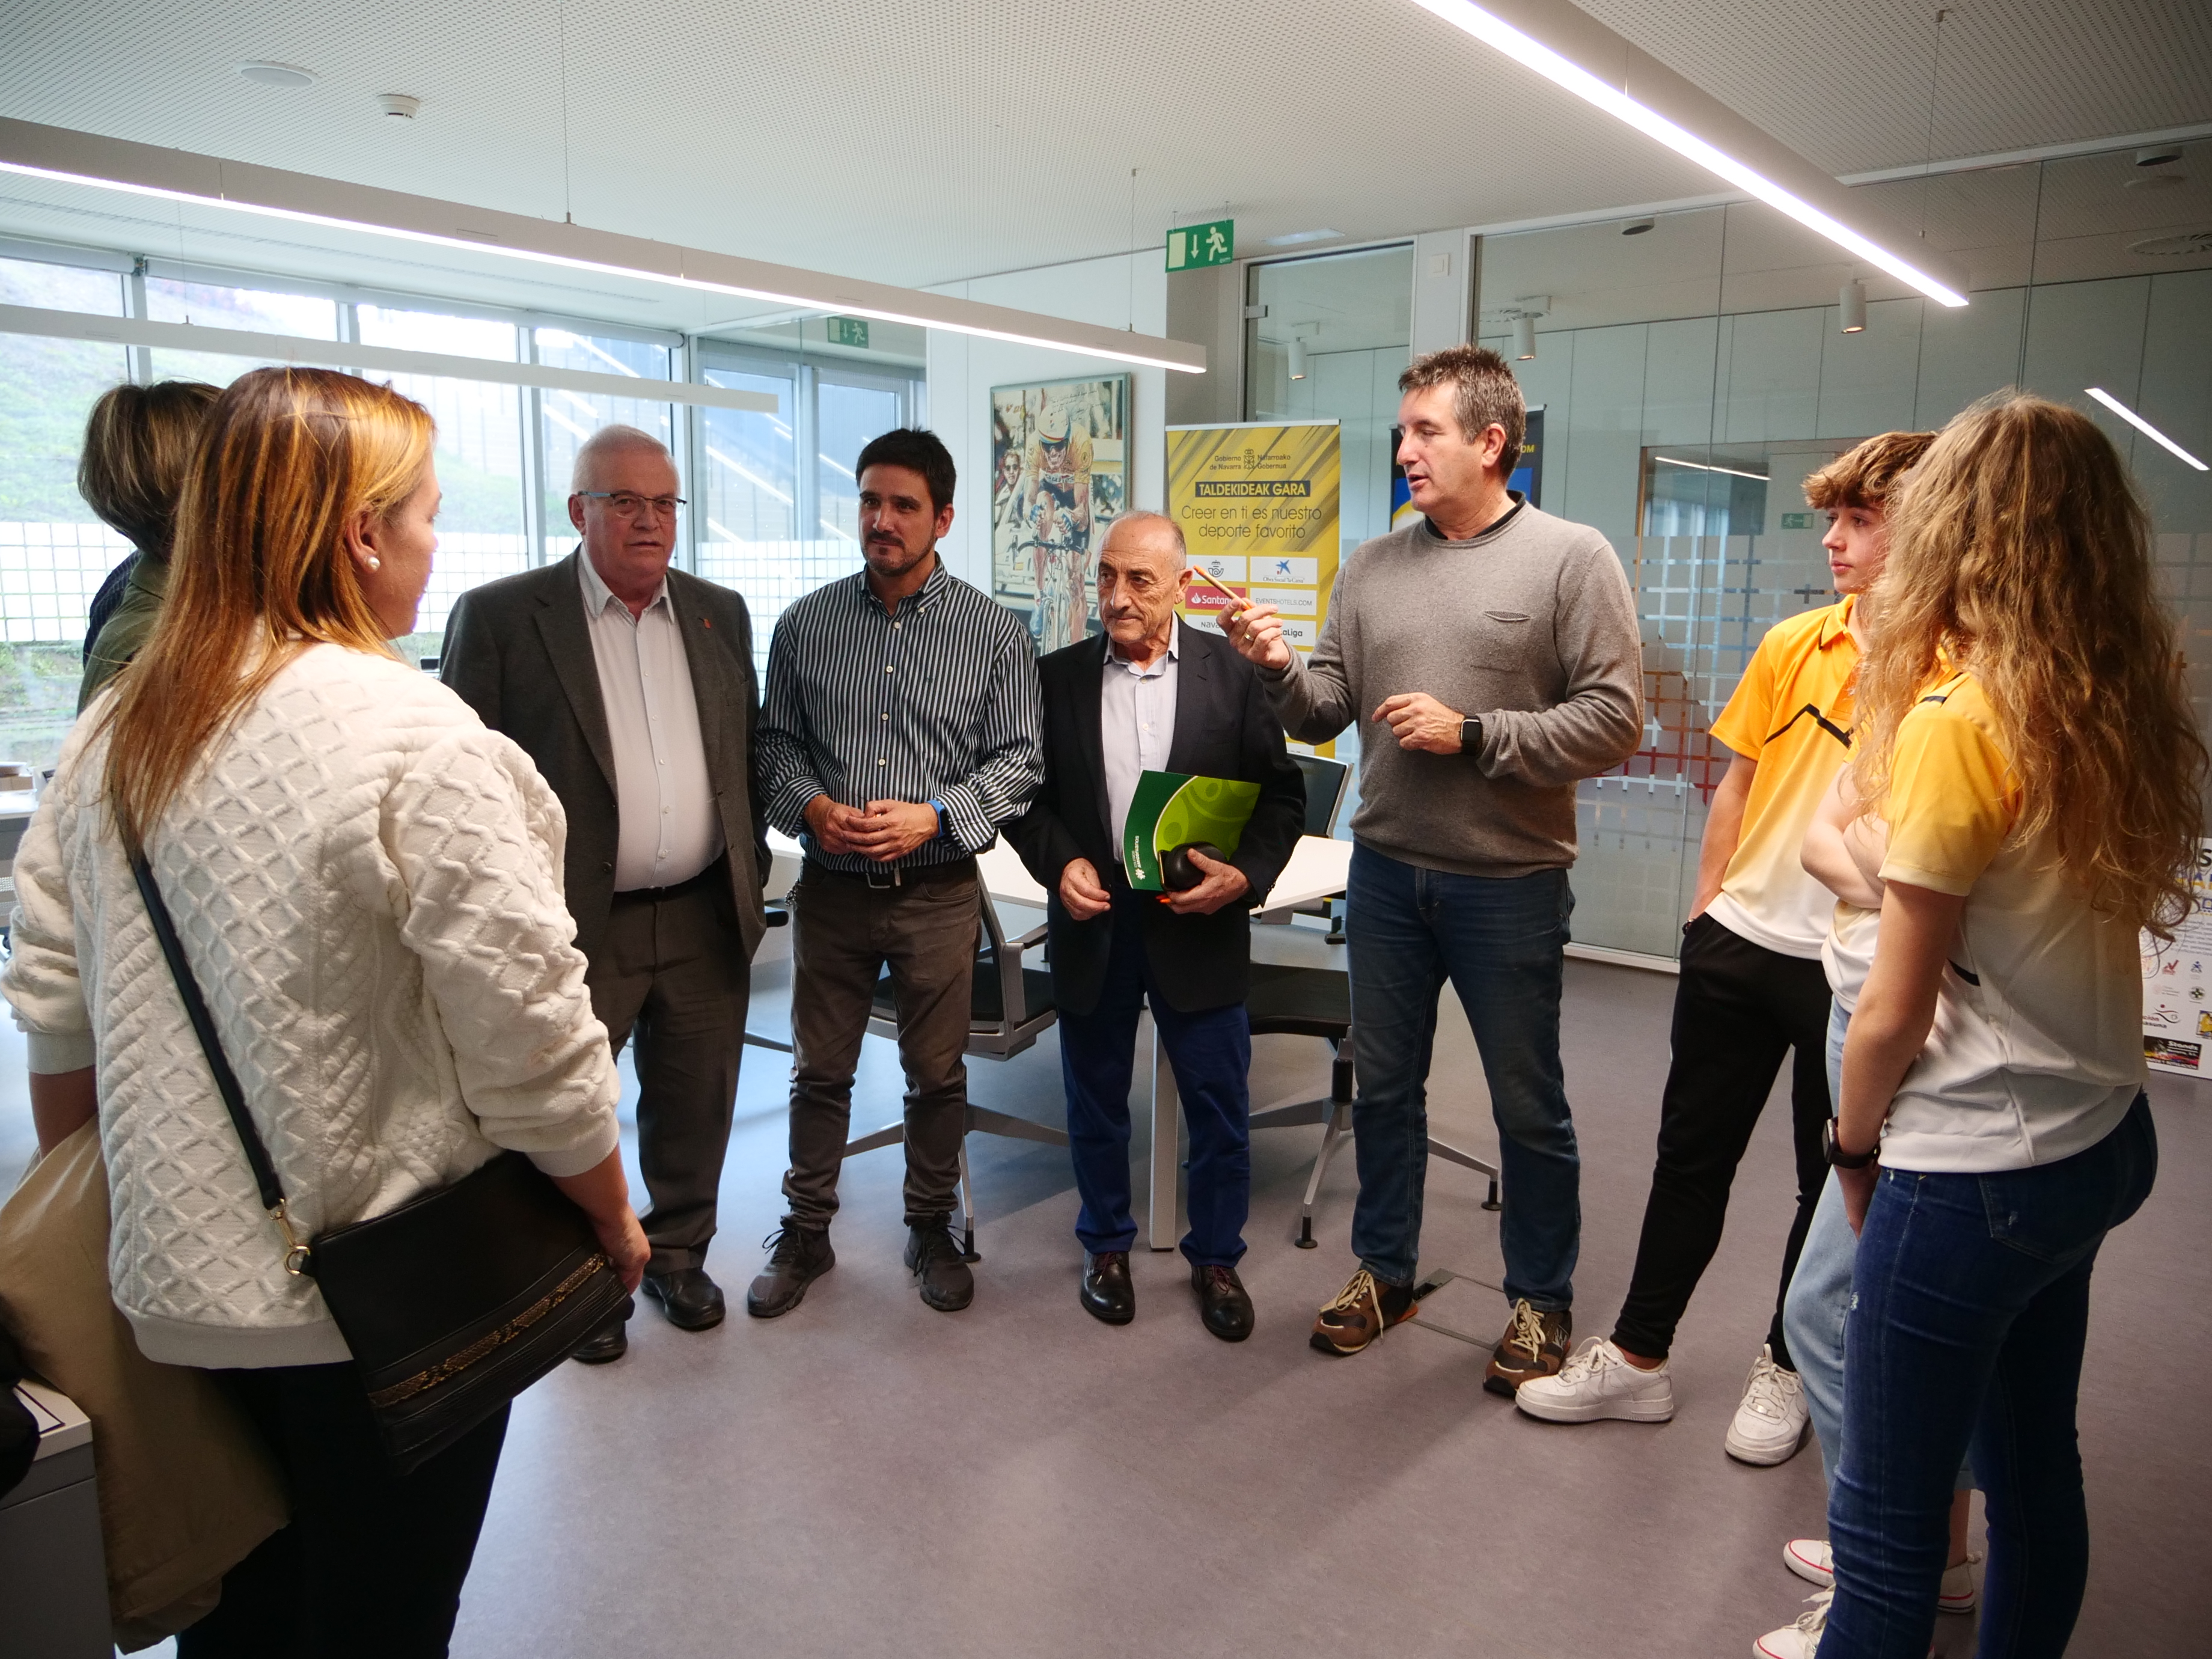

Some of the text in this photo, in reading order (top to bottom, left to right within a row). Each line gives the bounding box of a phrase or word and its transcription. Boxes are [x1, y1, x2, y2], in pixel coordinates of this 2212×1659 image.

[1521, 445, 1535, 453] OM
[1199, 482, 1306, 496] TALDEKIDEAK GARA
[1181, 505, 1322, 521] Creer en ti es nuestro
[1199, 524, 1306, 540] deporte favorito
[1202, 595, 1231, 605] Santan
[1256, 597, 1312, 606] EVENTSHOTELS.COM
[1281, 628, 1303, 638] aLiga
